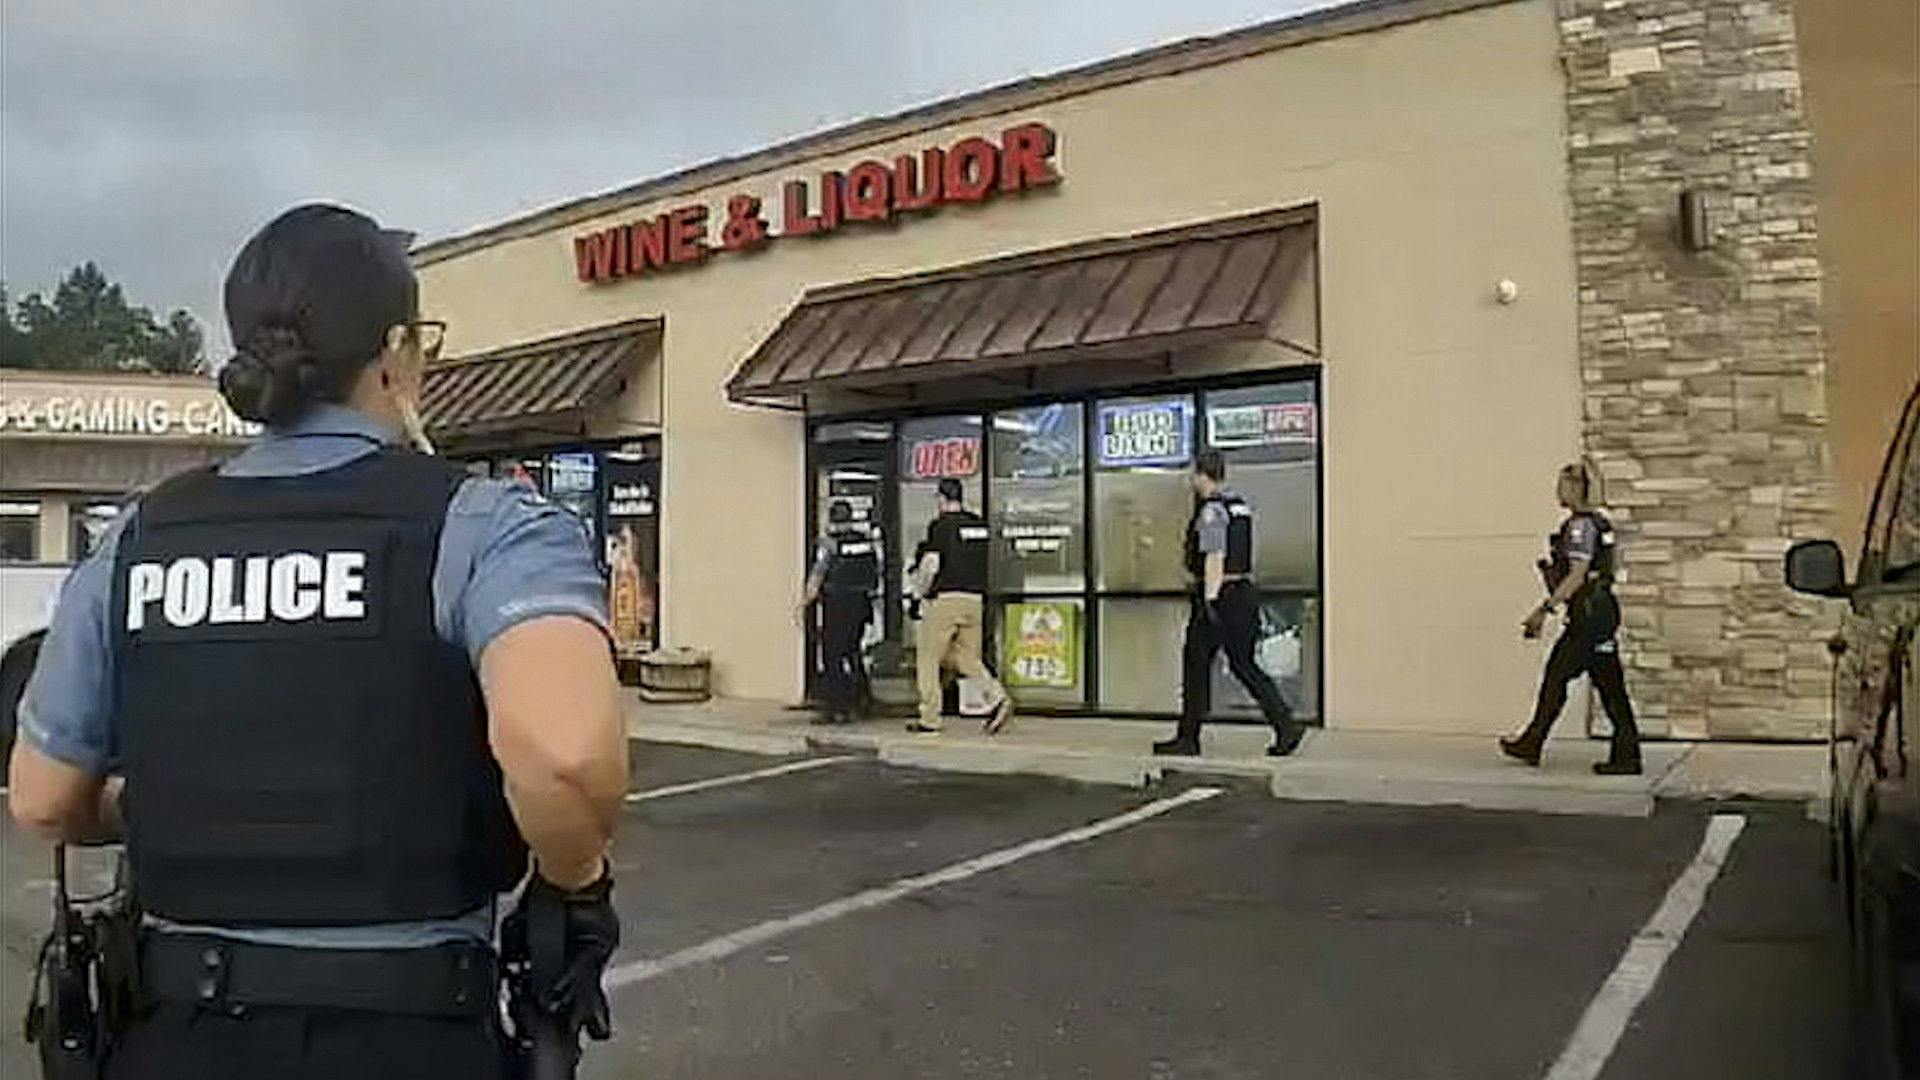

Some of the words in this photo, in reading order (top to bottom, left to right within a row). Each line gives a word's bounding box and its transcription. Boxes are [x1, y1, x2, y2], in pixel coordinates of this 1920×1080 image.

[574, 205, 709, 283] WINE
[721, 194, 769, 251] &
[783, 122, 1060, 237] LIQUOR
[47, 396, 171, 434] GAMING
[127, 551, 367, 632] POLICE
